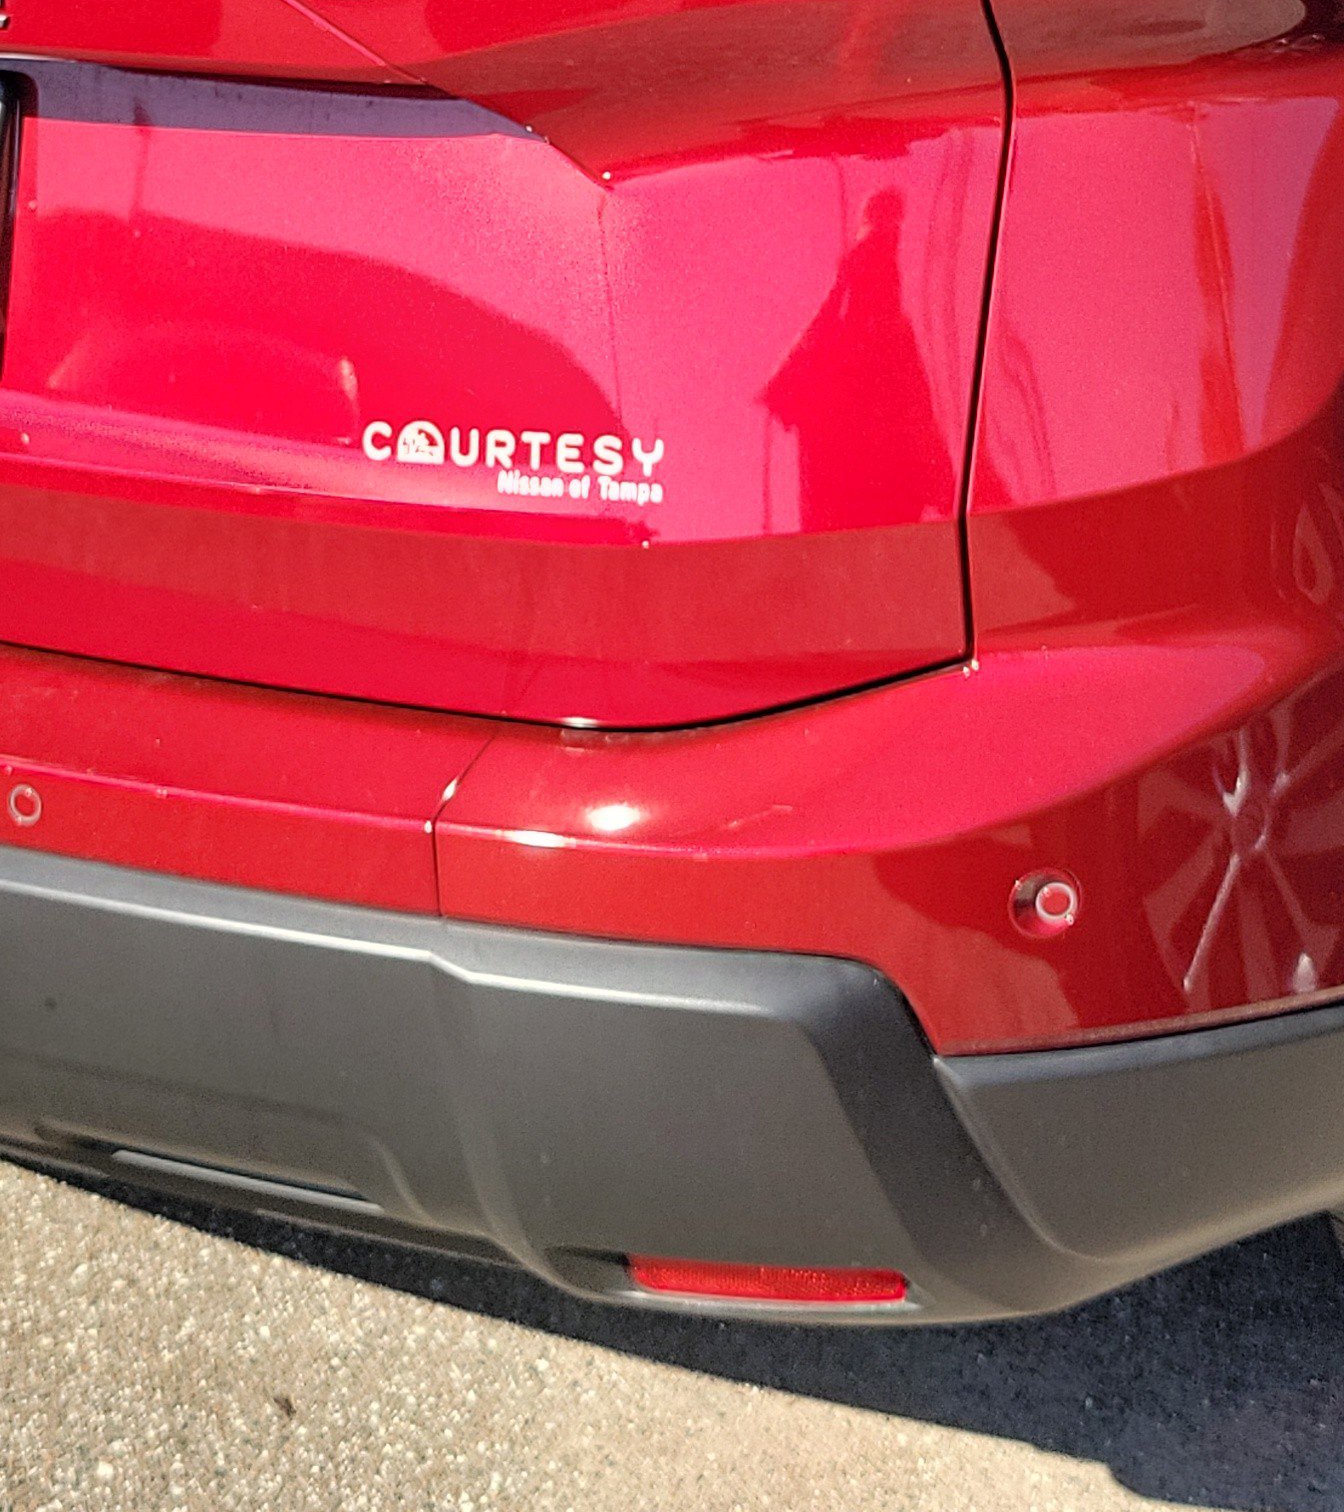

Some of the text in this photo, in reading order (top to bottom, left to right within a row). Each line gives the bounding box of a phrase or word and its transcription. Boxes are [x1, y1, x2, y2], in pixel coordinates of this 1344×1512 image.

[362, 420, 665, 478] COURTESY
[497, 469, 664, 506] Nissan of Tampa
